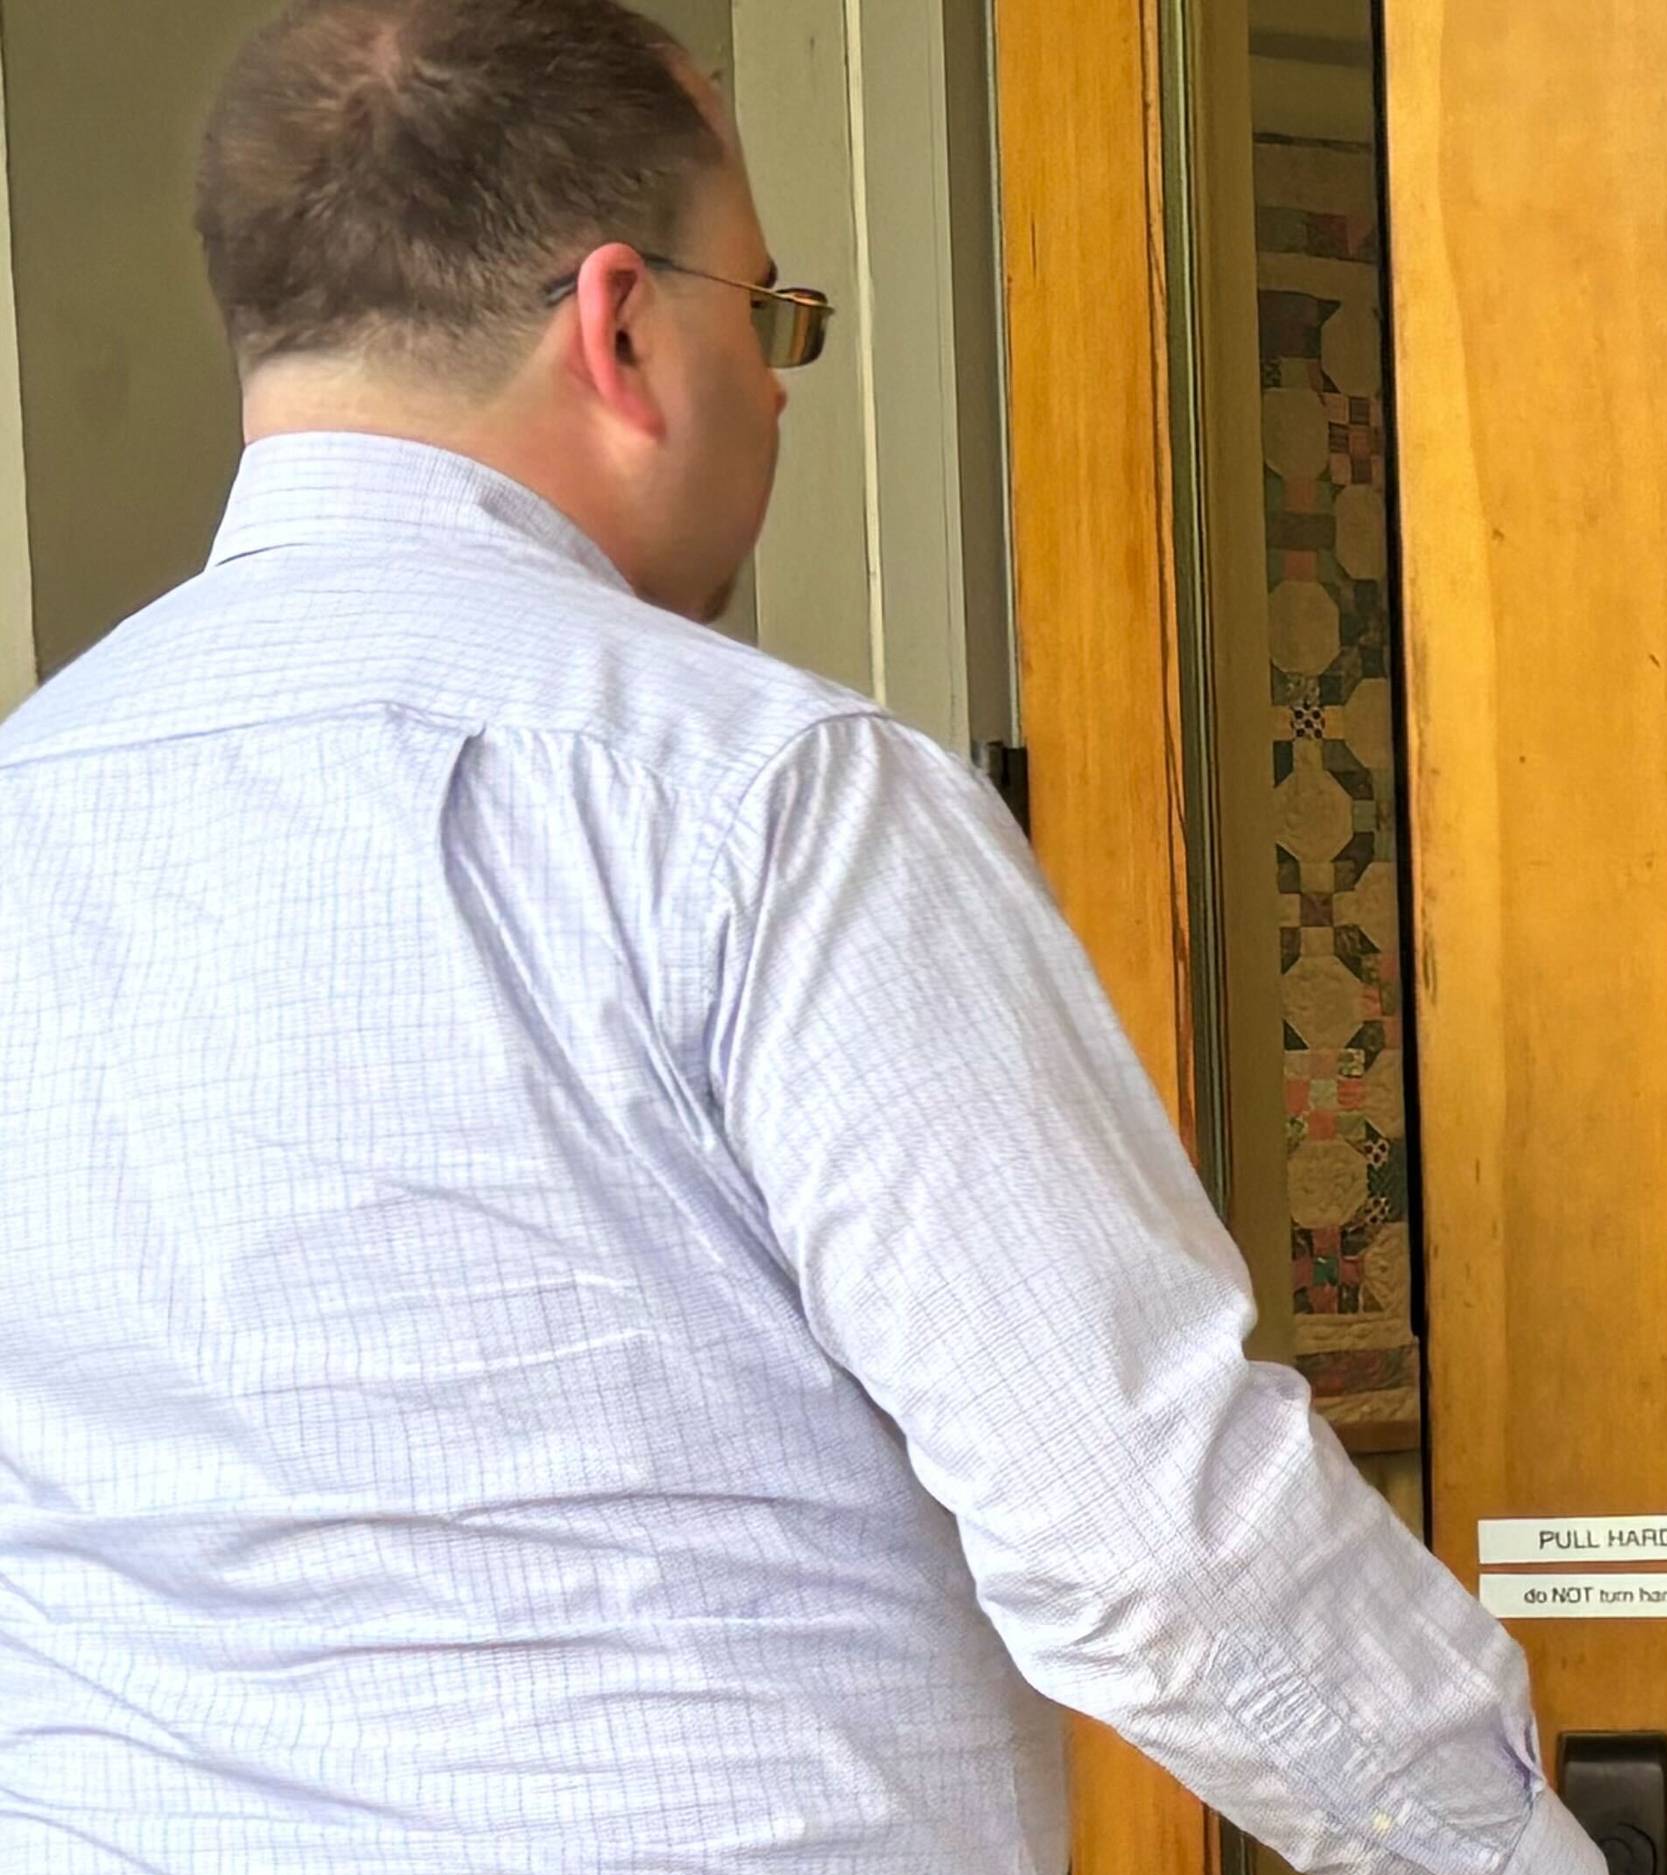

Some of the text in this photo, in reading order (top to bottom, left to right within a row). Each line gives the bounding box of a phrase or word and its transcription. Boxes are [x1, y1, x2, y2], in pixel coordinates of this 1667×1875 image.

[1539, 1530, 1599, 1549] PULL
[1524, 1587, 1547, 1603] do
[1552, 1587, 1593, 1603] NOT
[1600, 1588, 1633, 1602] turn
